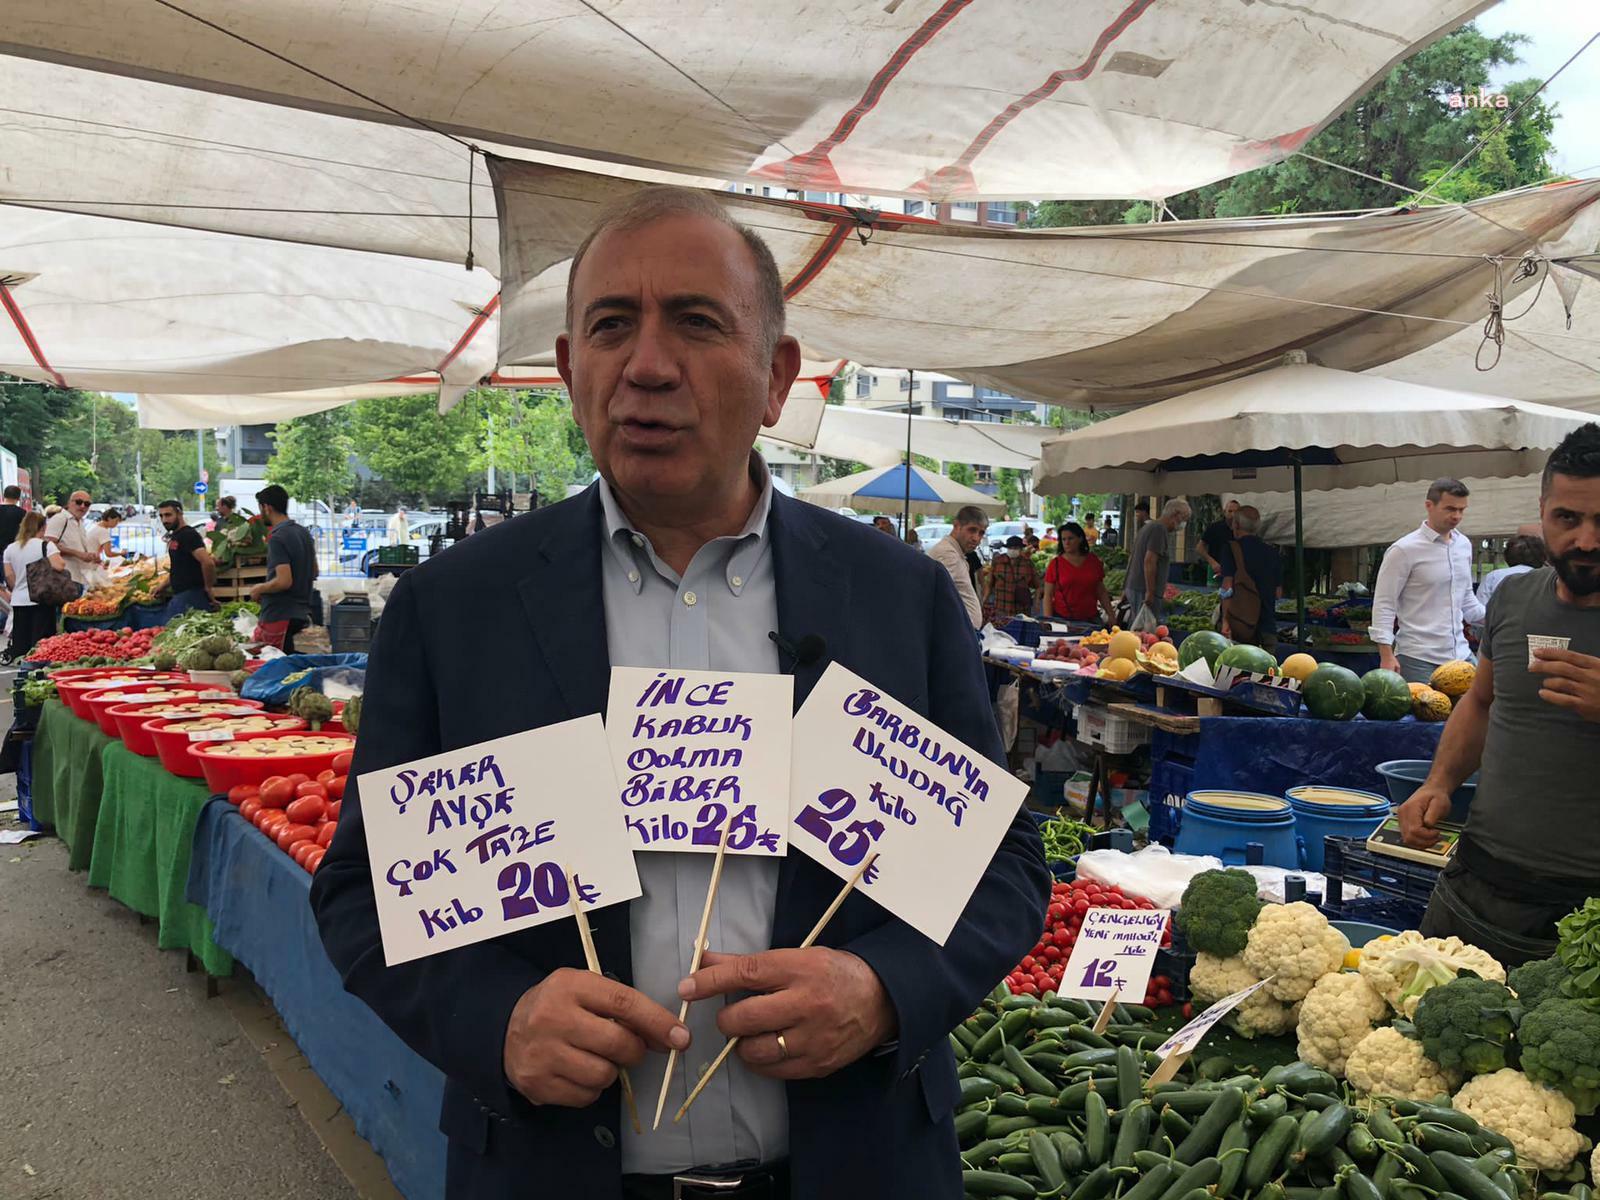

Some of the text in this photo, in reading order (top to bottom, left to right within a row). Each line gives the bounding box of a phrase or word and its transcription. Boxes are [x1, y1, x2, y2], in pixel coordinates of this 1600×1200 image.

[632, 714, 753, 741] KABUK
[843, 688, 990, 802] BARBUNYA
[627, 746, 743, 771] DOLMA
[852, 727, 970, 827] ULUDAĞ
[390, 754, 506, 814] ŞEKER
[427, 787, 516, 835] AYŞE
[624, 814, 689, 844] Kilo
[386, 820, 556, 897] ÇOK TAZE
[418, 898, 484, 939] Kilo
